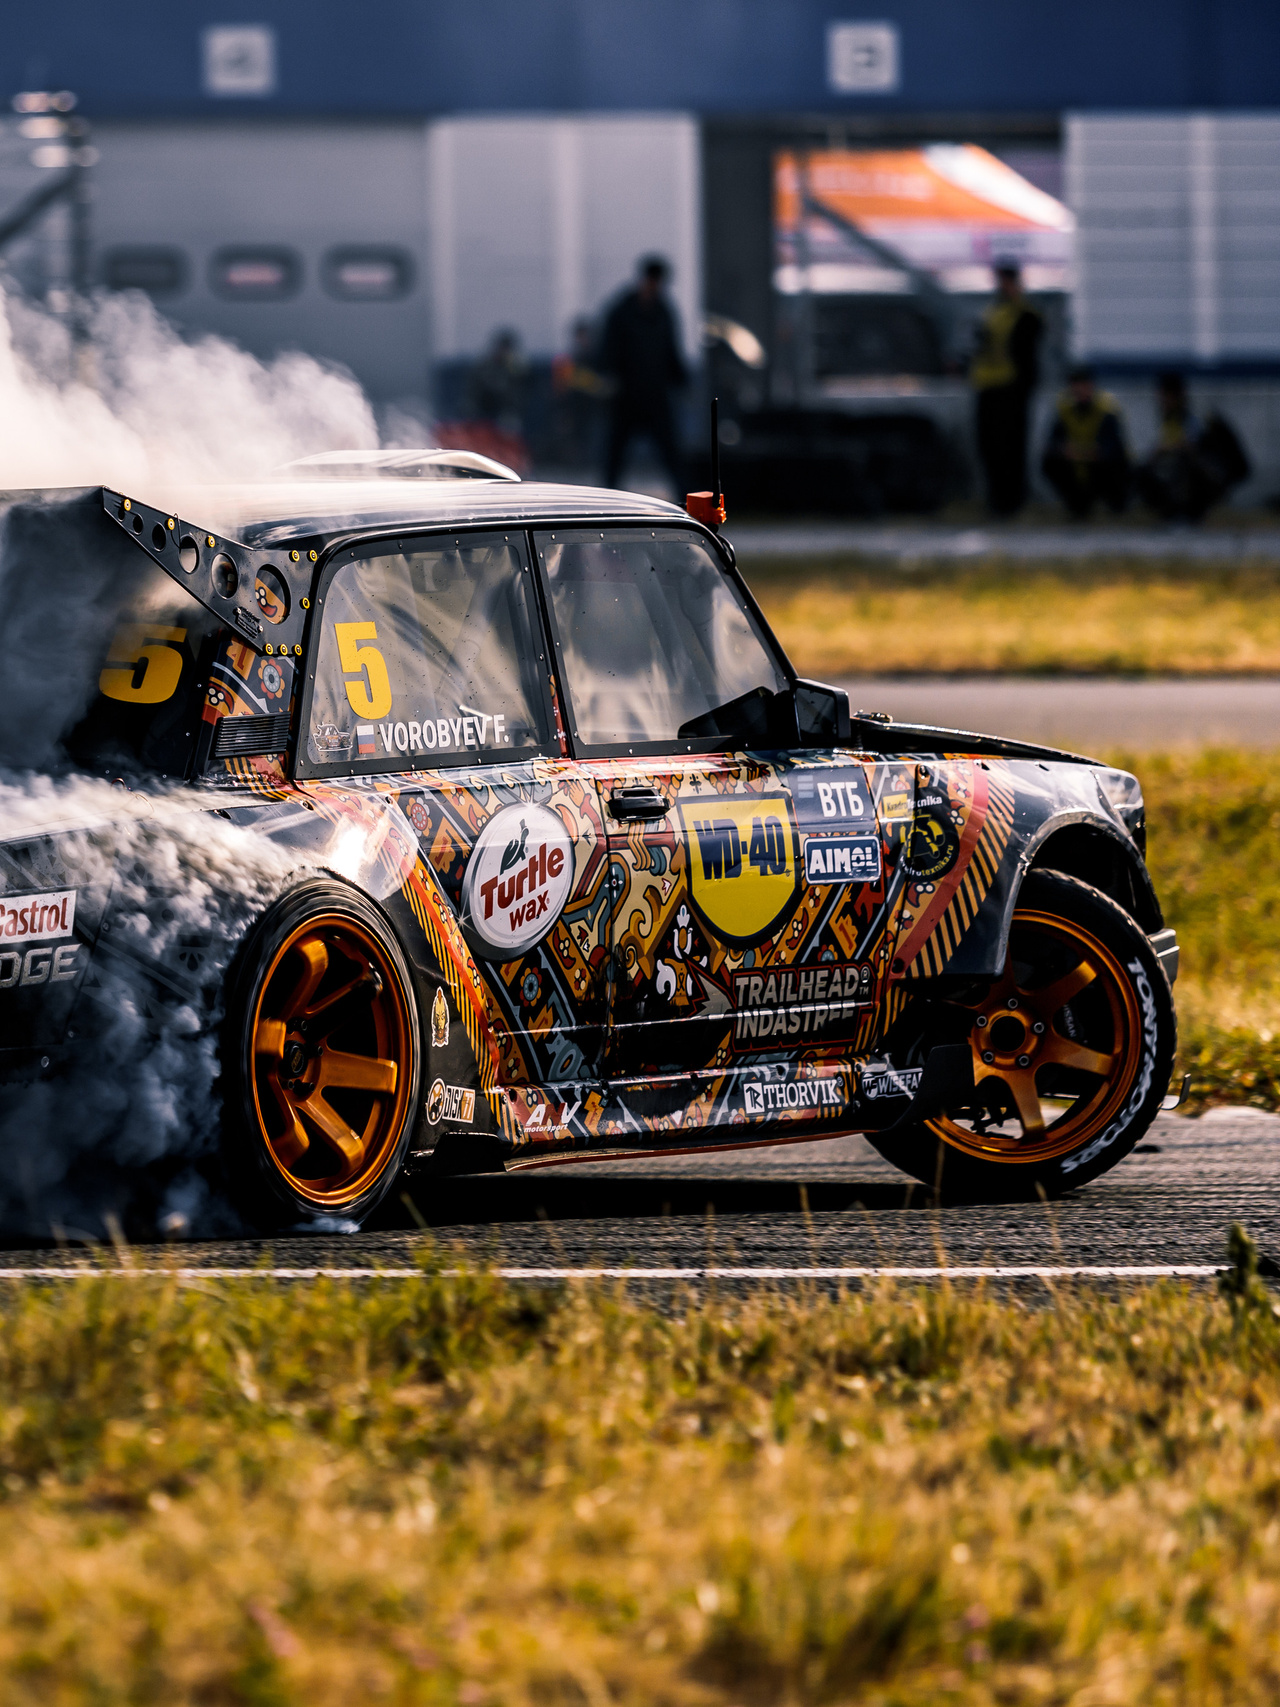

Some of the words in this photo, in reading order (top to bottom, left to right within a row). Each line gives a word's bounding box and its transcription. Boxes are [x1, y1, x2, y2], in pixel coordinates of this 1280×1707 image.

[98, 623, 187, 704] 5
[335, 621, 392, 719] 5
[379, 716, 488, 752] VOROBYEV
[493, 714, 509, 744] F.
[817, 781, 864, 818] ВТБ
[693, 816, 787, 880] WD-40
[809, 847, 877, 875] AIMOL
[480, 843, 565, 920] Turtle
[509, 890, 549, 932] wax
[736, 967, 859, 1006] TRAILHEAD
[736, 999, 856, 1039] INDASTREE
[763, 1078, 840, 1108] THORVIK
[879, 1072, 923, 1093] WISEFA
[524, 1123, 568, 1133] motorsport
